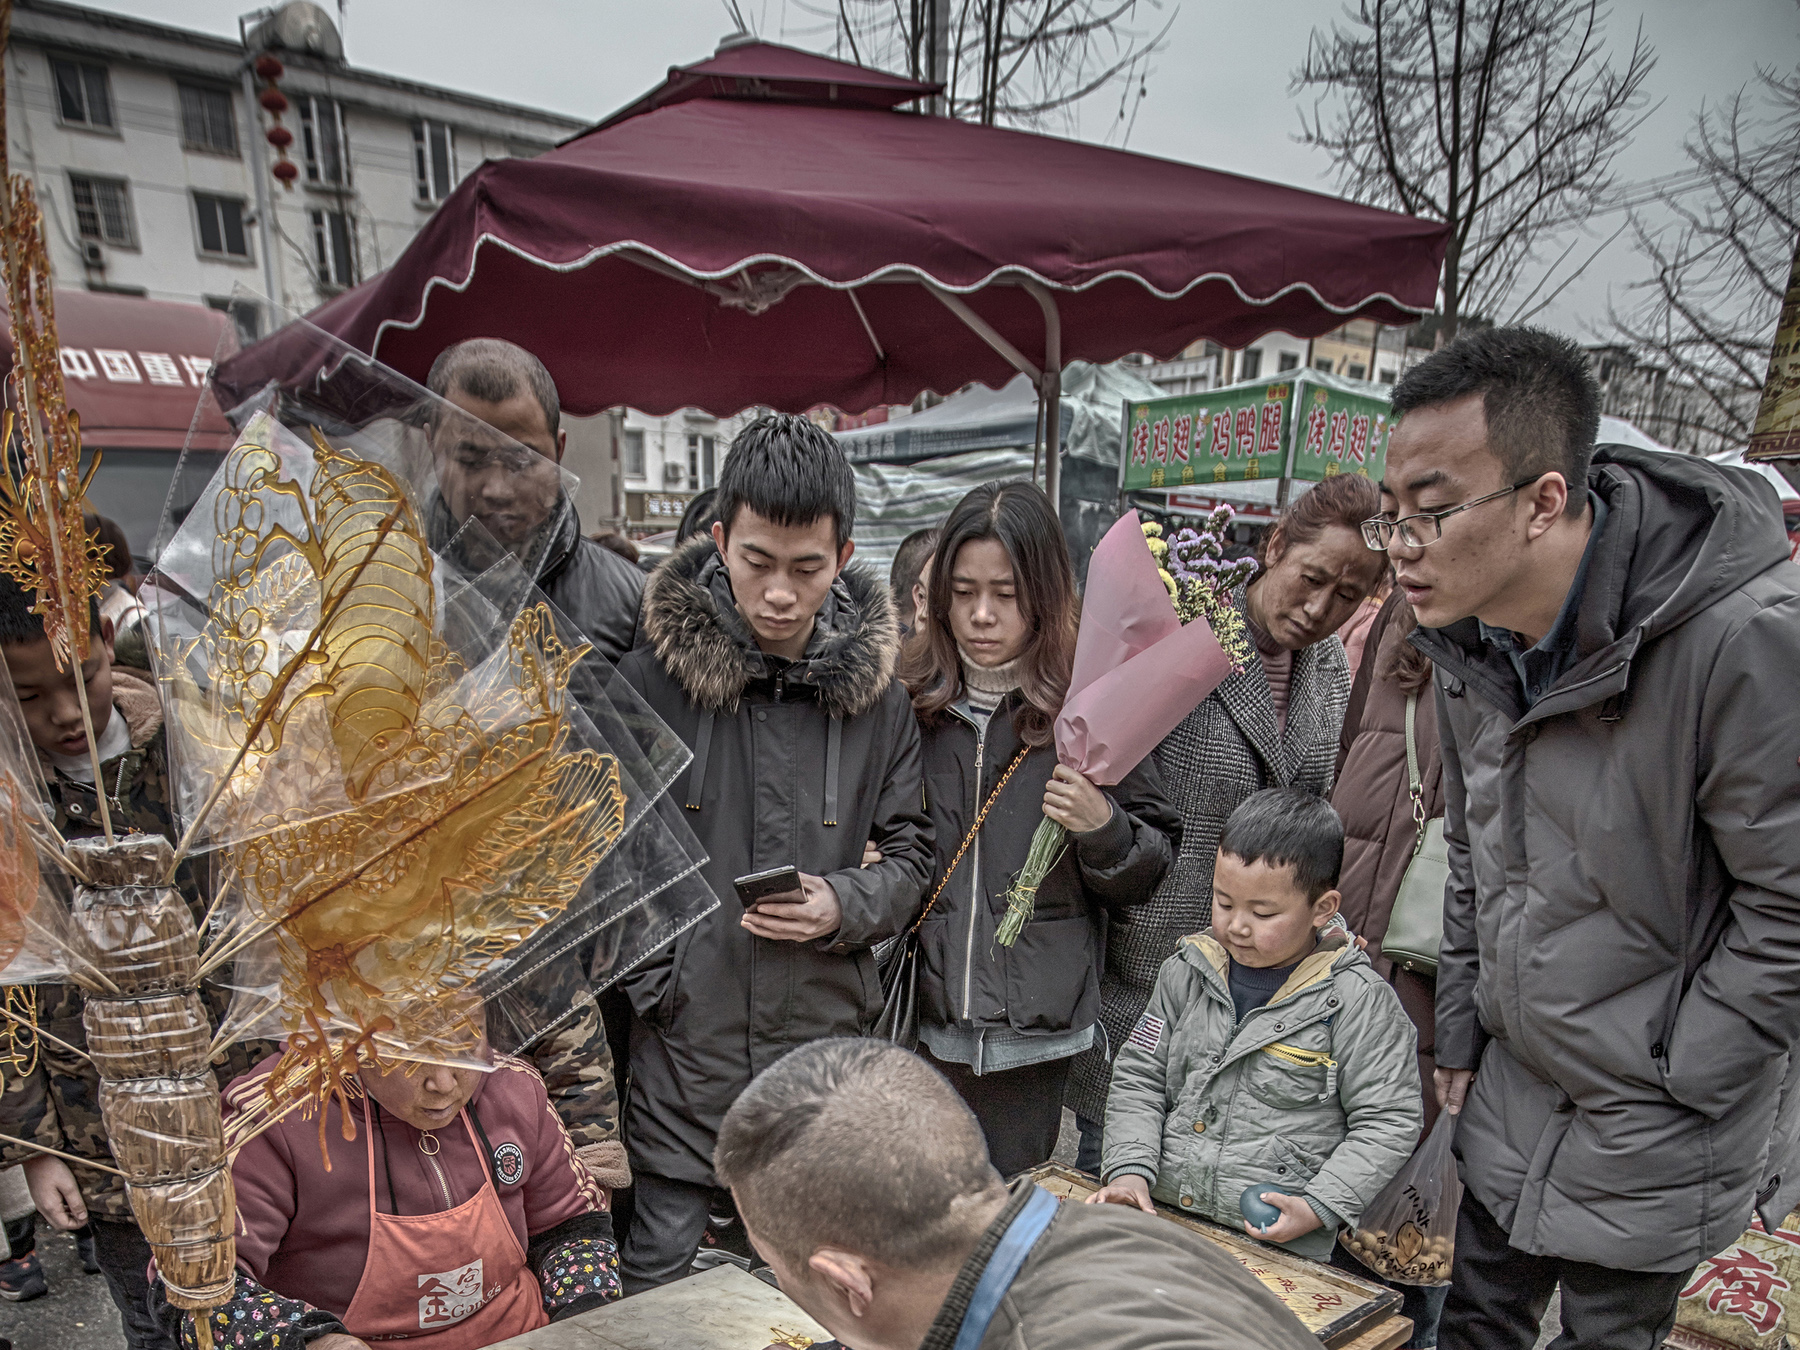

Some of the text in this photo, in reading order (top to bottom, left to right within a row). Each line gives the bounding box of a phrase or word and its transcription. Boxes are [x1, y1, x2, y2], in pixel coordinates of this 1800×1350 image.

[1131, 400, 1284, 467] 烤鸡翅 鸡鸭腿
[1305, 402, 1370, 465] 烤鸡翅
[1150, 457, 1260, 487] 绿色食品
